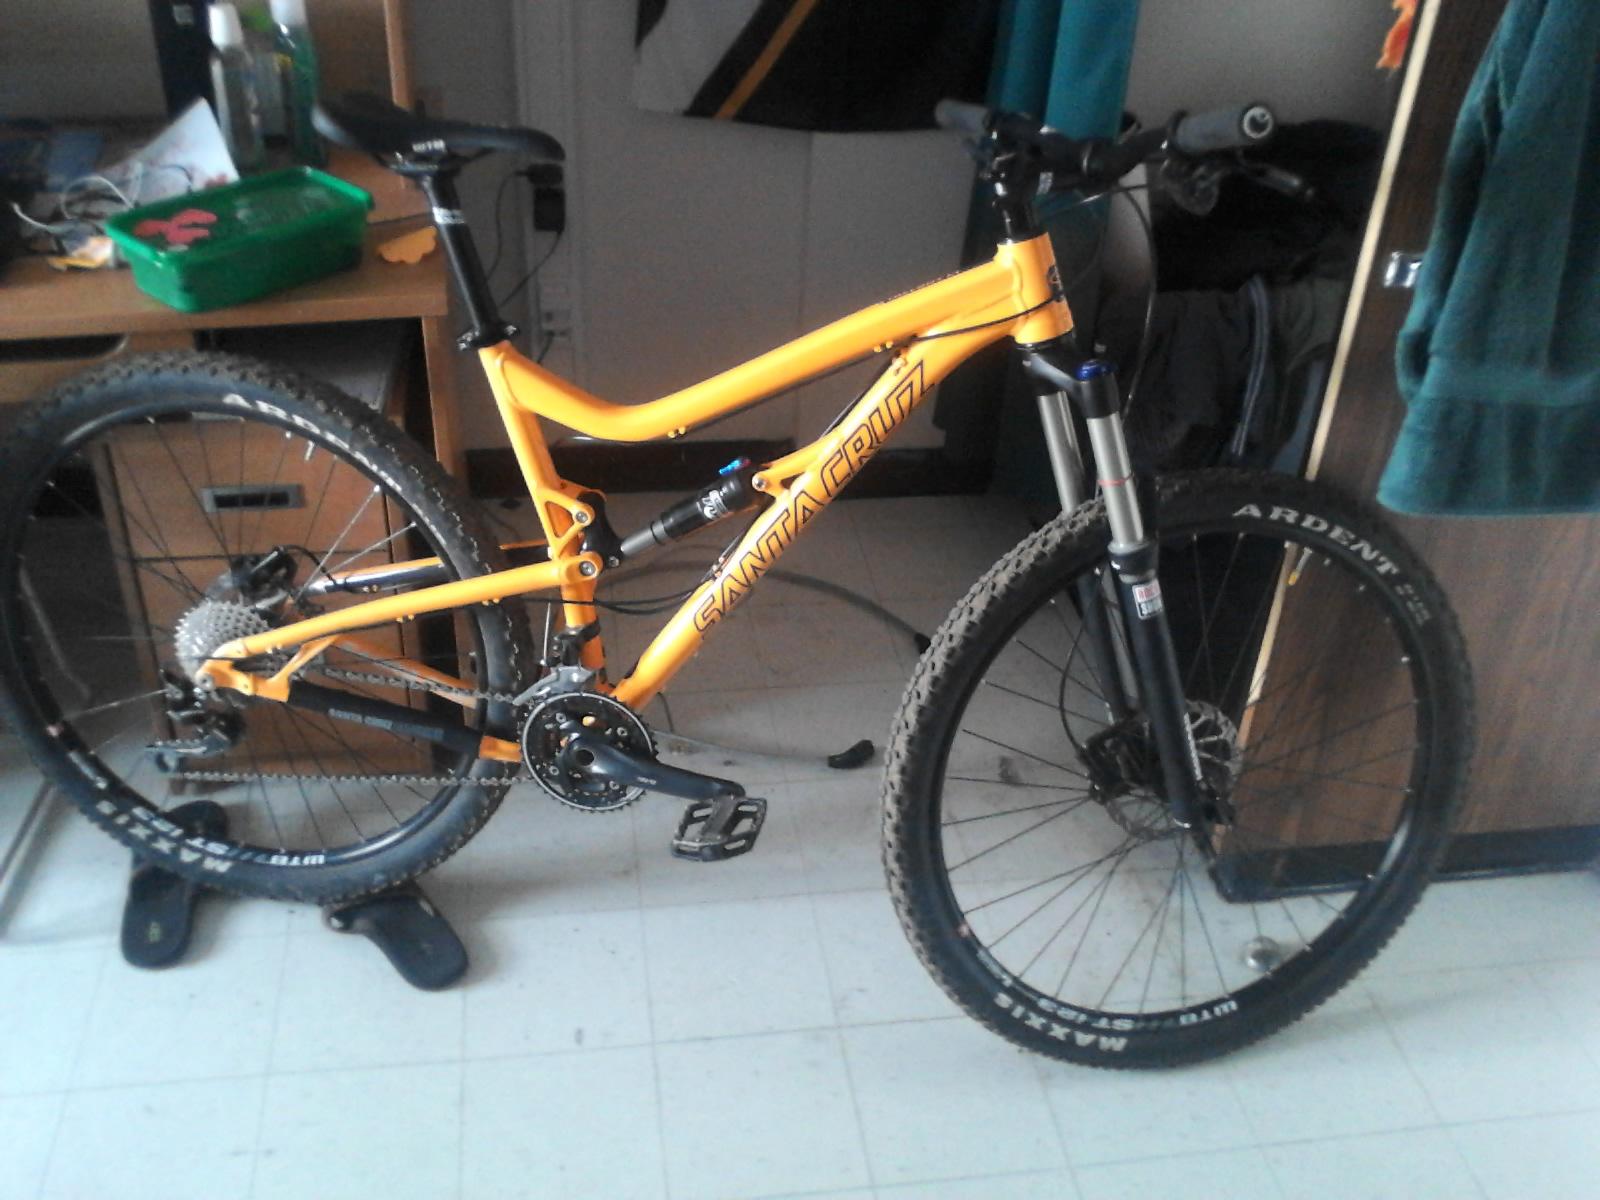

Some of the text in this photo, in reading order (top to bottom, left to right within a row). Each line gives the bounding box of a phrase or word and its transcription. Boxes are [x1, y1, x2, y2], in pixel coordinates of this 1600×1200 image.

[693, 490, 825, 633] SANTA
[1232, 503, 1400, 575] ARDENT
[993, 992, 1128, 1051] MAXXIS
